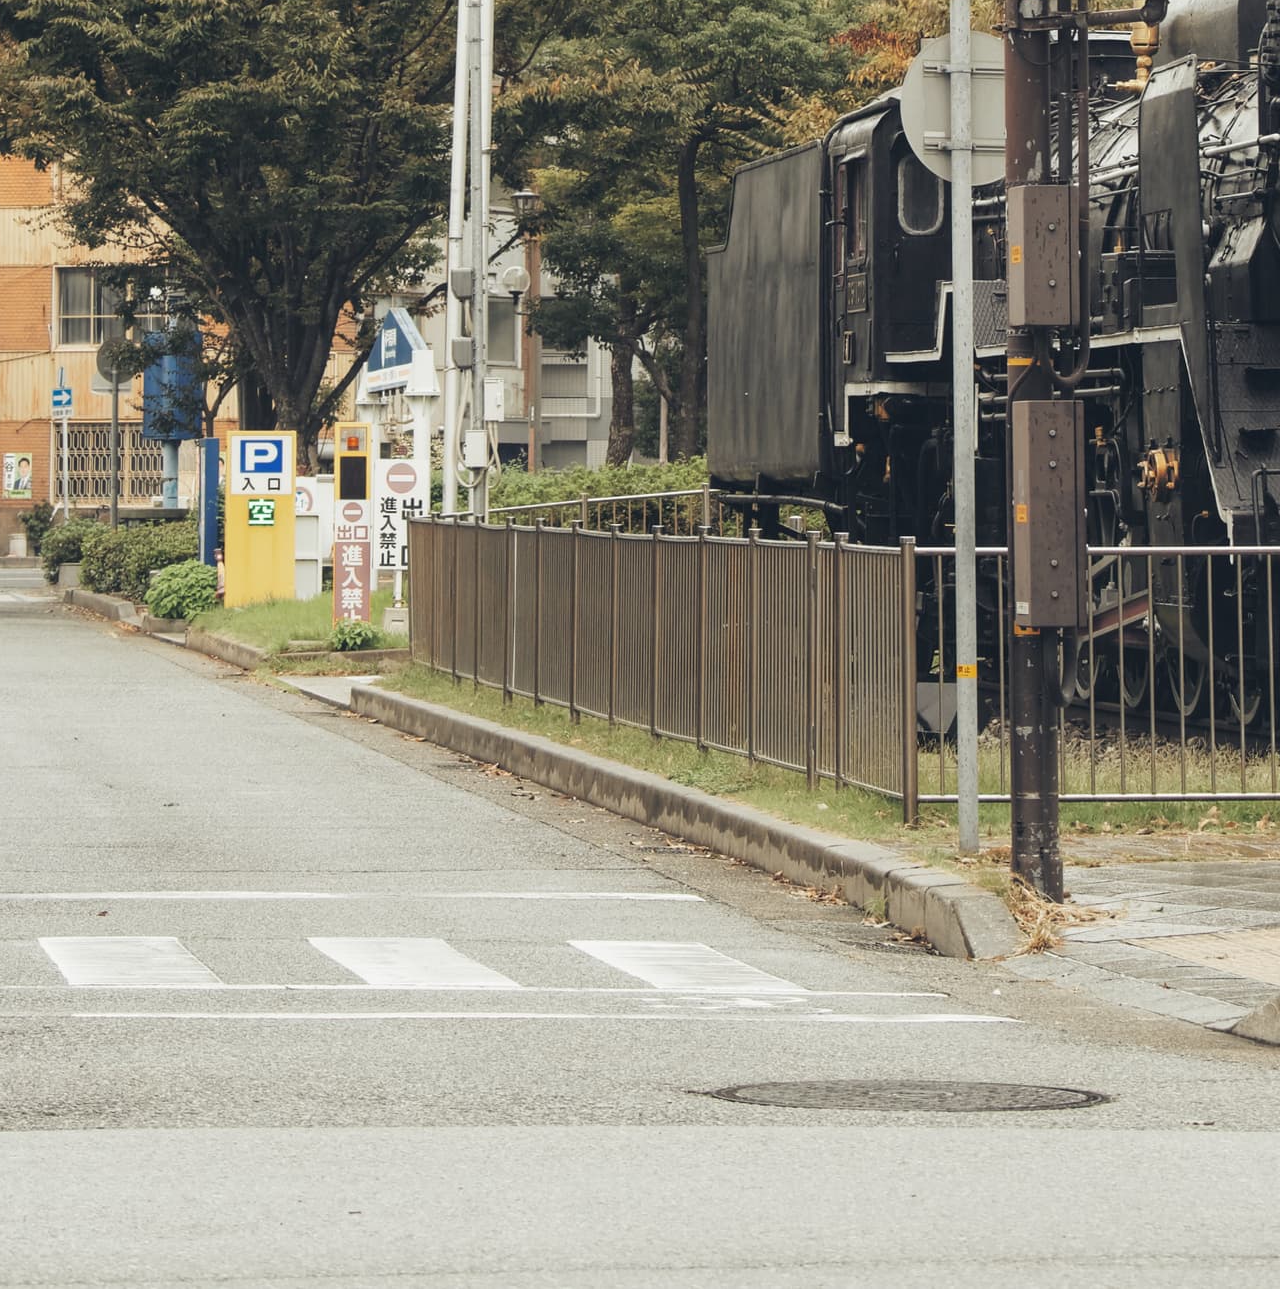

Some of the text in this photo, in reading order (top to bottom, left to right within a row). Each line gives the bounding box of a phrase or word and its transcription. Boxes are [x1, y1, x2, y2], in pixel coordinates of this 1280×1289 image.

[245, 442, 278, 471] P
[242, 478, 280, 491] 入口
[248, 498, 275, 526] 空
[337, 525, 368, 540] 出口
[379, 497, 398, 567] 進入禁止
